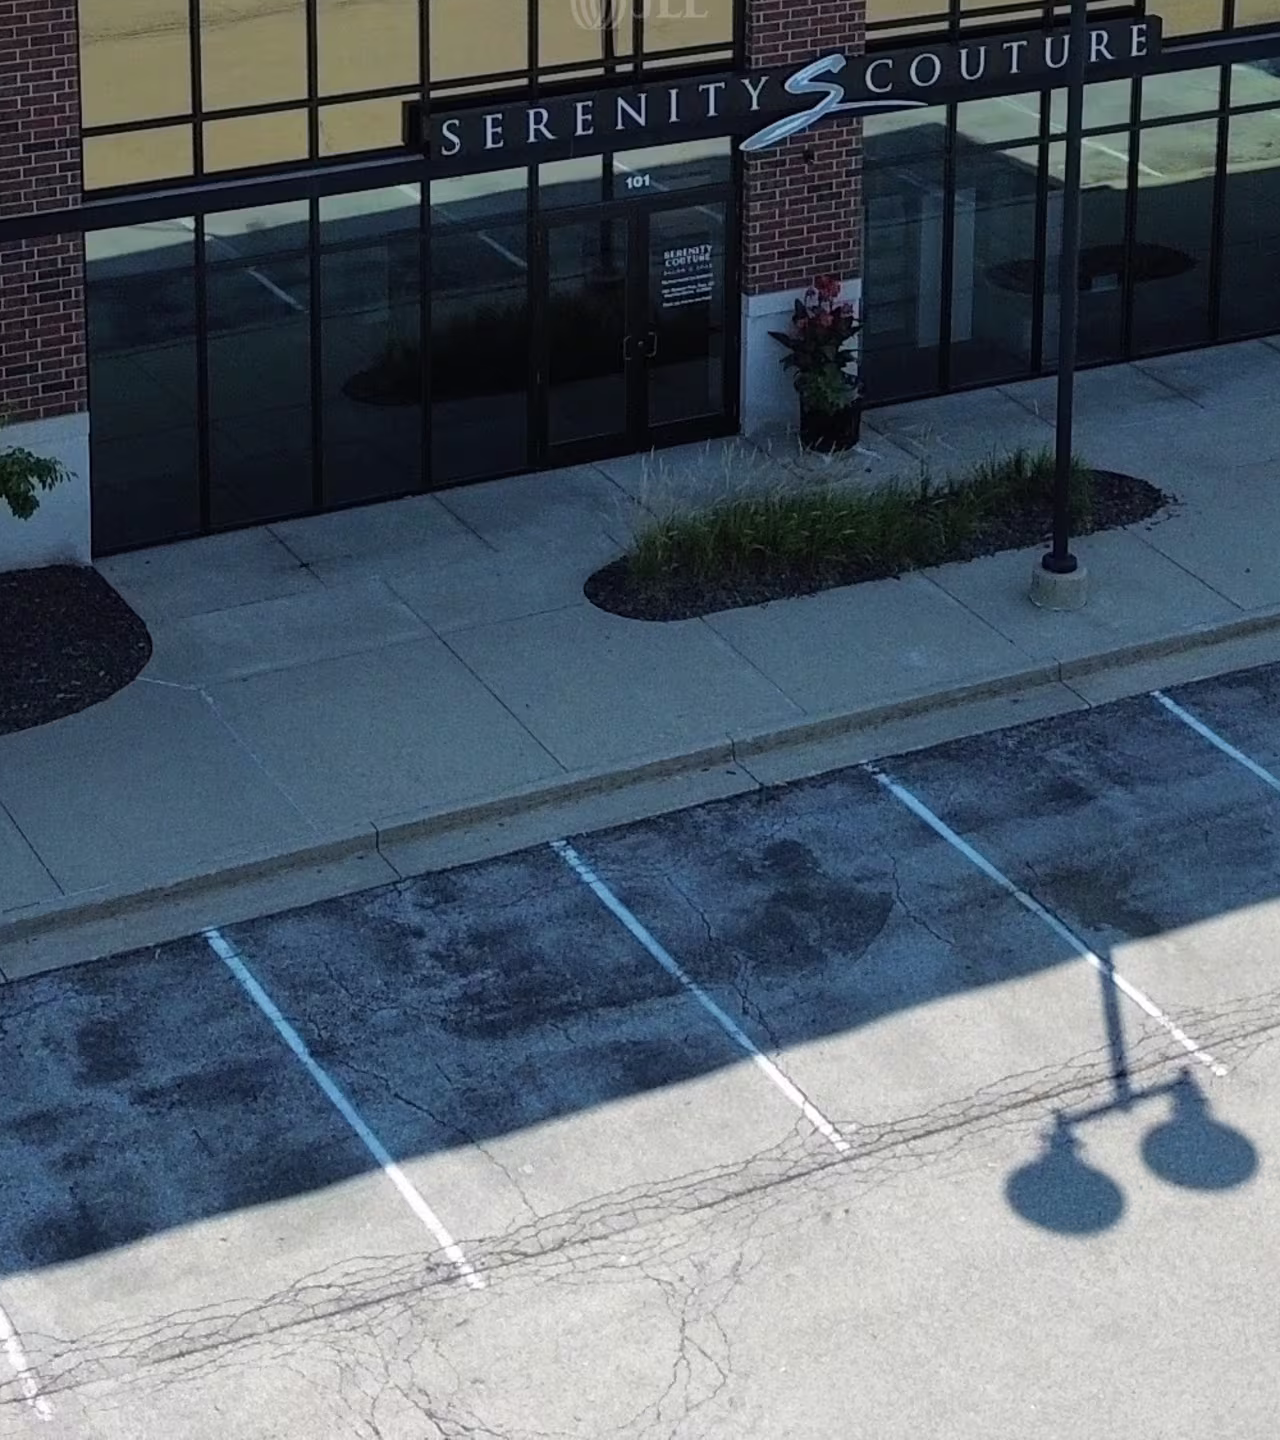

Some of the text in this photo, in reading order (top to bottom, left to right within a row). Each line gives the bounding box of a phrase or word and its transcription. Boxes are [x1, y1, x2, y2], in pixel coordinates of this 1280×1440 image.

[440, 76, 769, 156] SERENITY
[864, 23, 1148, 93] COUTURE
[625, 173, 650, 189] 101
